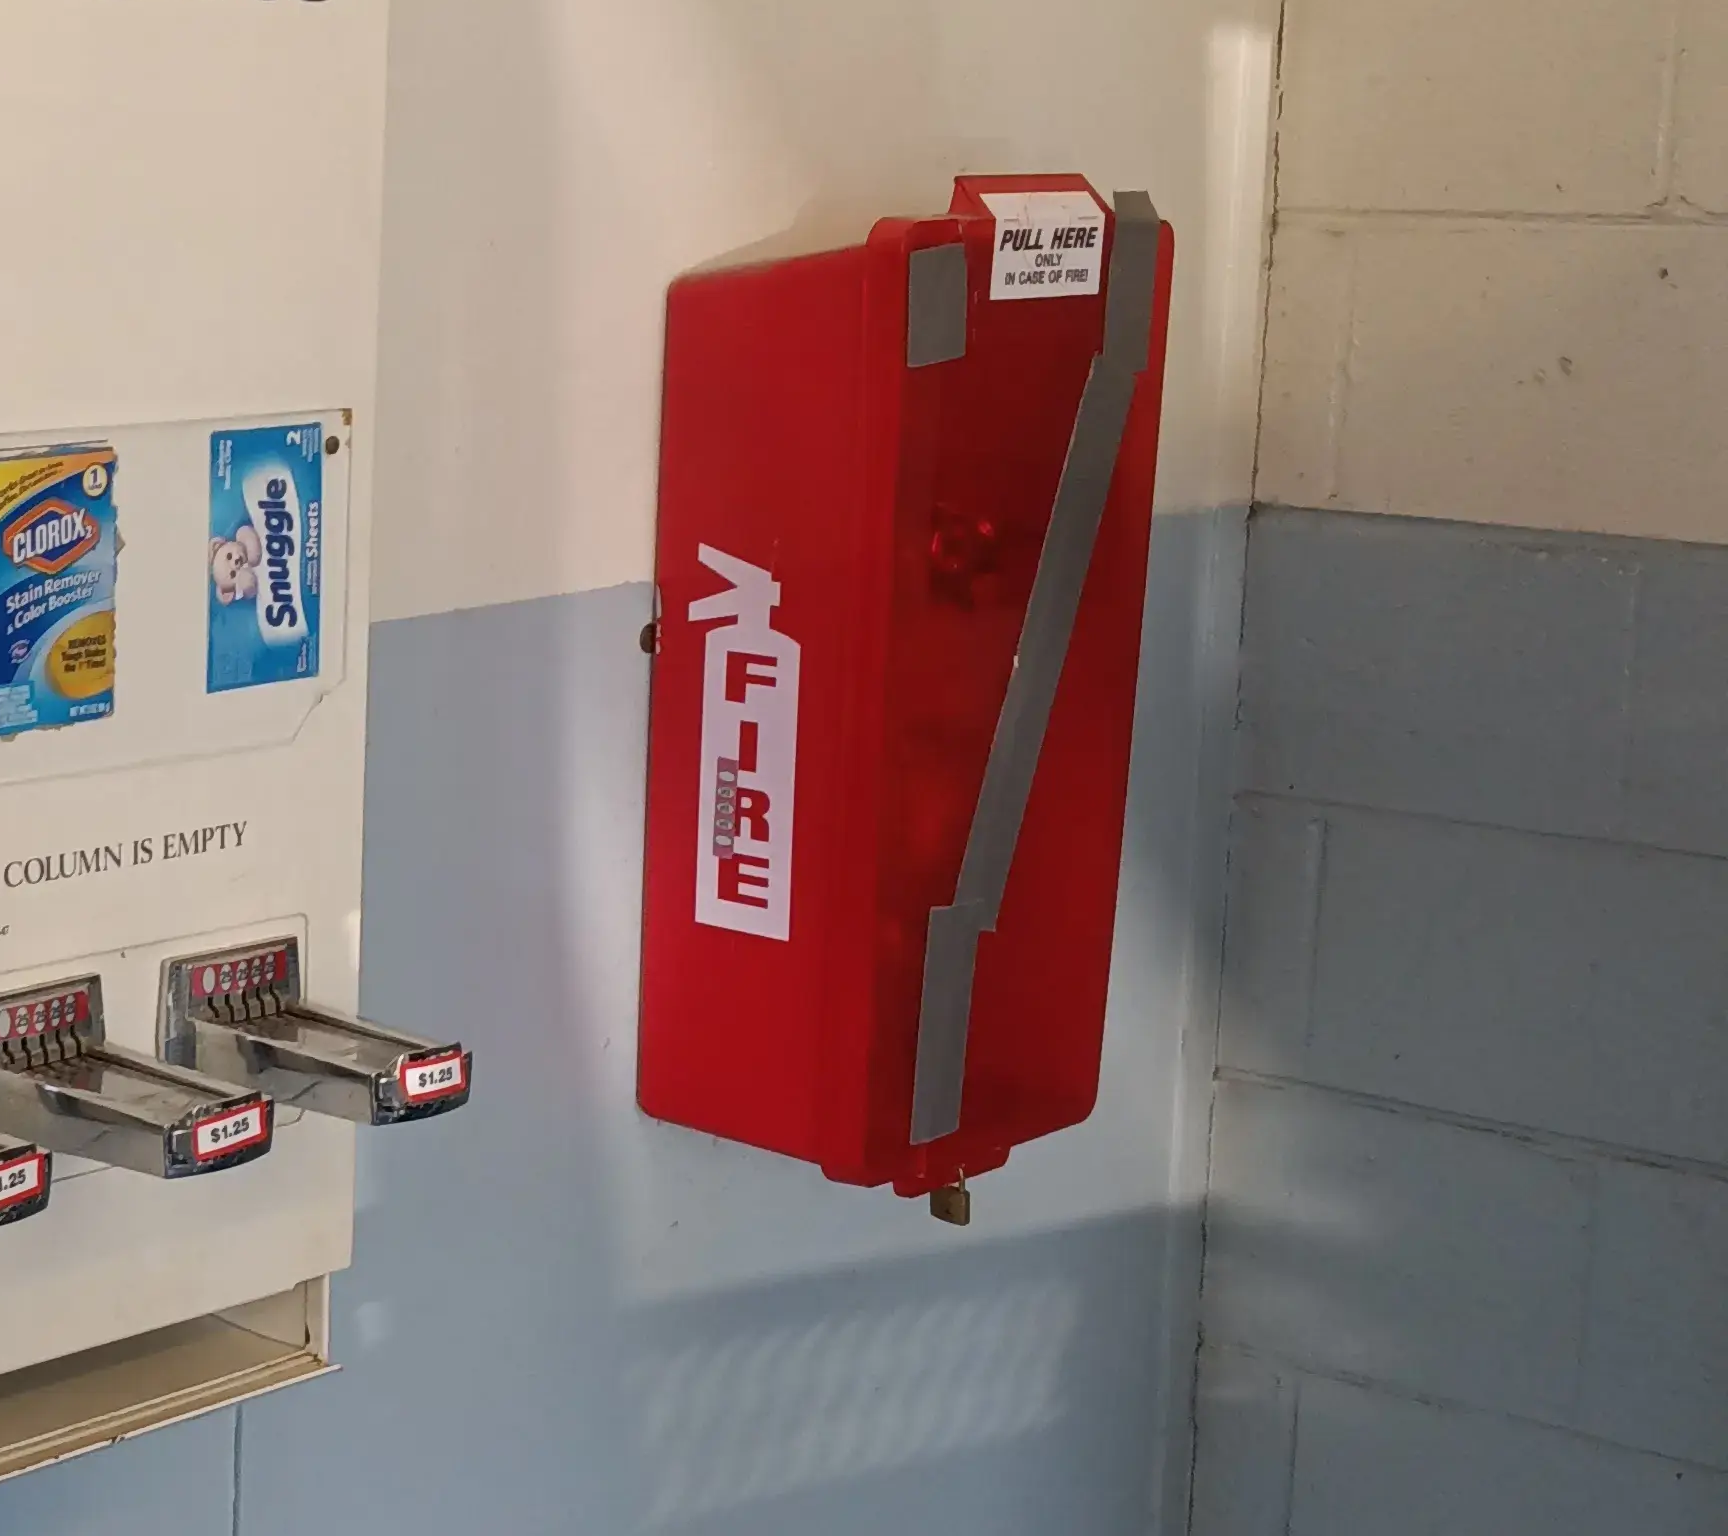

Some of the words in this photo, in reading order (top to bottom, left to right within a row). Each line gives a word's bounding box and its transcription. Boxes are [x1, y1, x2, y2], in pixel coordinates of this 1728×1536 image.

[999, 228, 1044, 251] PULL
[1050, 226, 1099, 249] HERE
[1004, 272, 1016, 286] IN
[1018, 270, 1045, 285] CASE
[1048, 269, 1063, 284] OF
[1034, 253, 1063, 268] ONLY
[306, 501, 319, 559] Sheets
[258, 477, 298, 628] Snuggle
[6, 583, 43, 614] Stain
[44, 570, 101, 595] Remover
[14, 602, 47, 629] Color
[48, 586, 93, 612] Booster
[3, 842, 123, 888] COLUMN
[132, 837, 153, 865] IS
[162, 820, 247, 860] EMPTY
[418, 1066, 454, 1089] $1.25
[210, 1117, 250, 1144] $1.25
